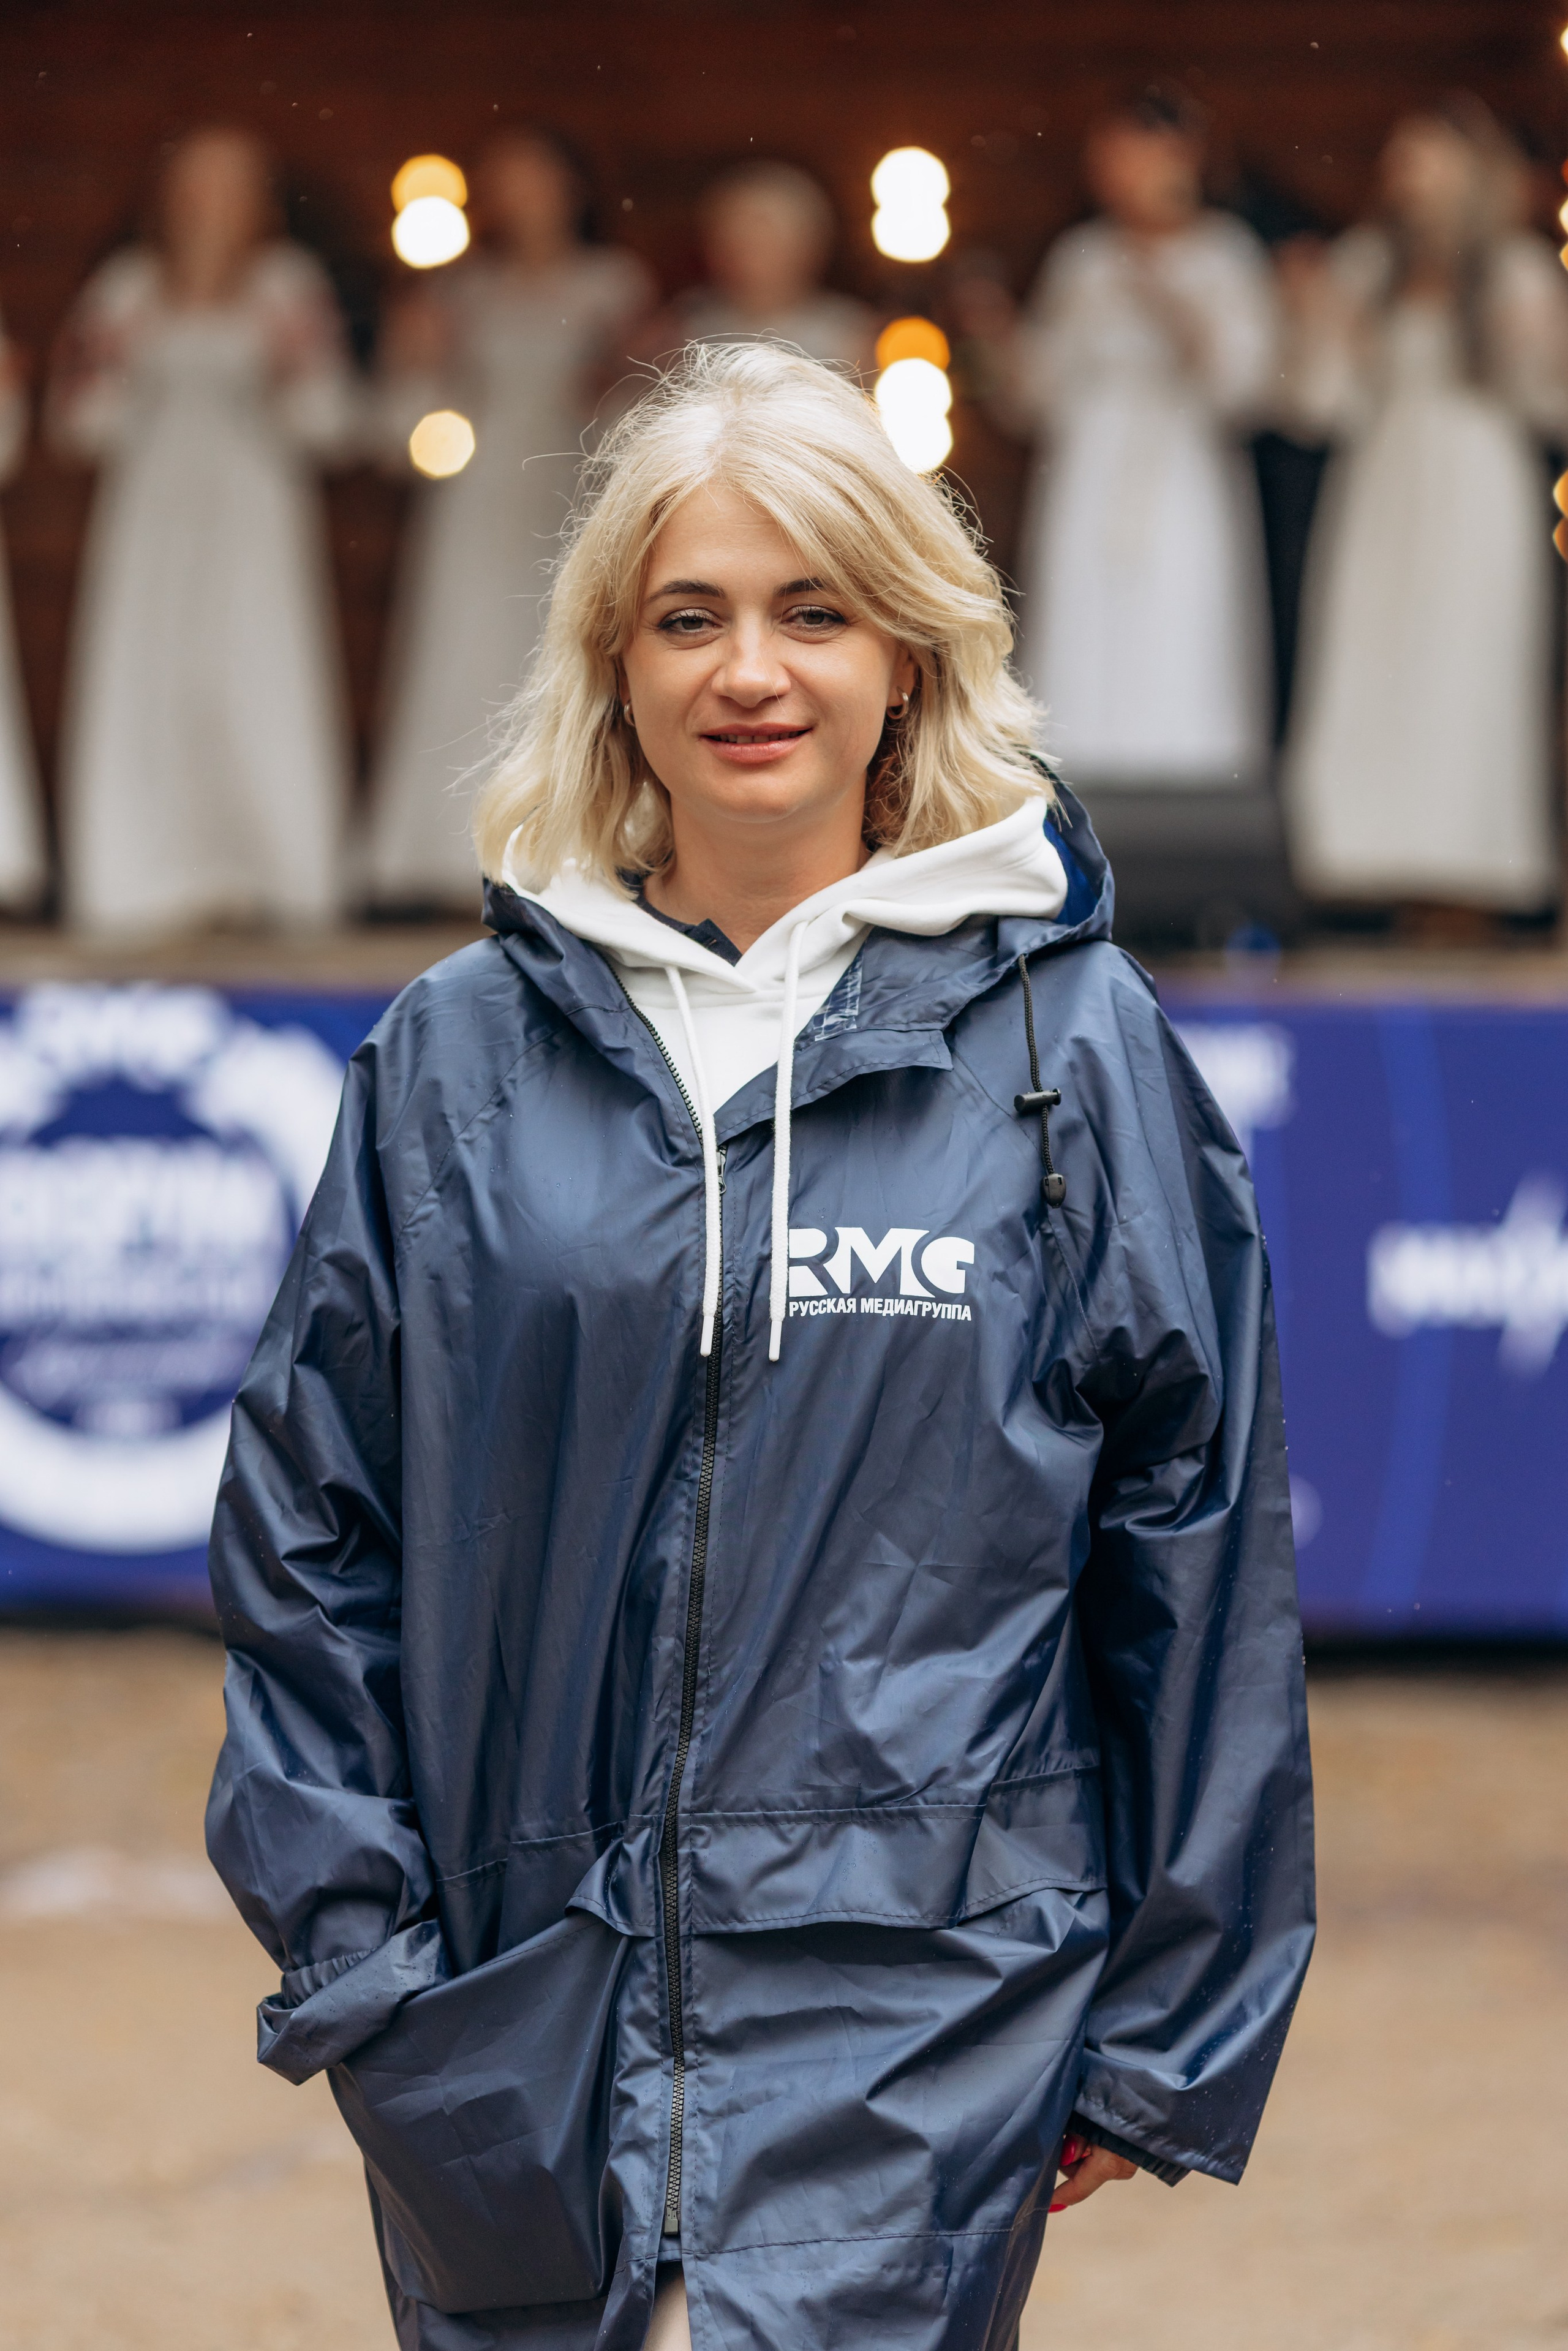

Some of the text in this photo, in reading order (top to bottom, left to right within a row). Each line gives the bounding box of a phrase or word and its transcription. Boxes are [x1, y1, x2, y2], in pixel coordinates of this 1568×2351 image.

[789, 1227, 974, 1297] RMG
[789, 1298, 971, 1321] РУССКАЯ МЕДИАГРУППА
